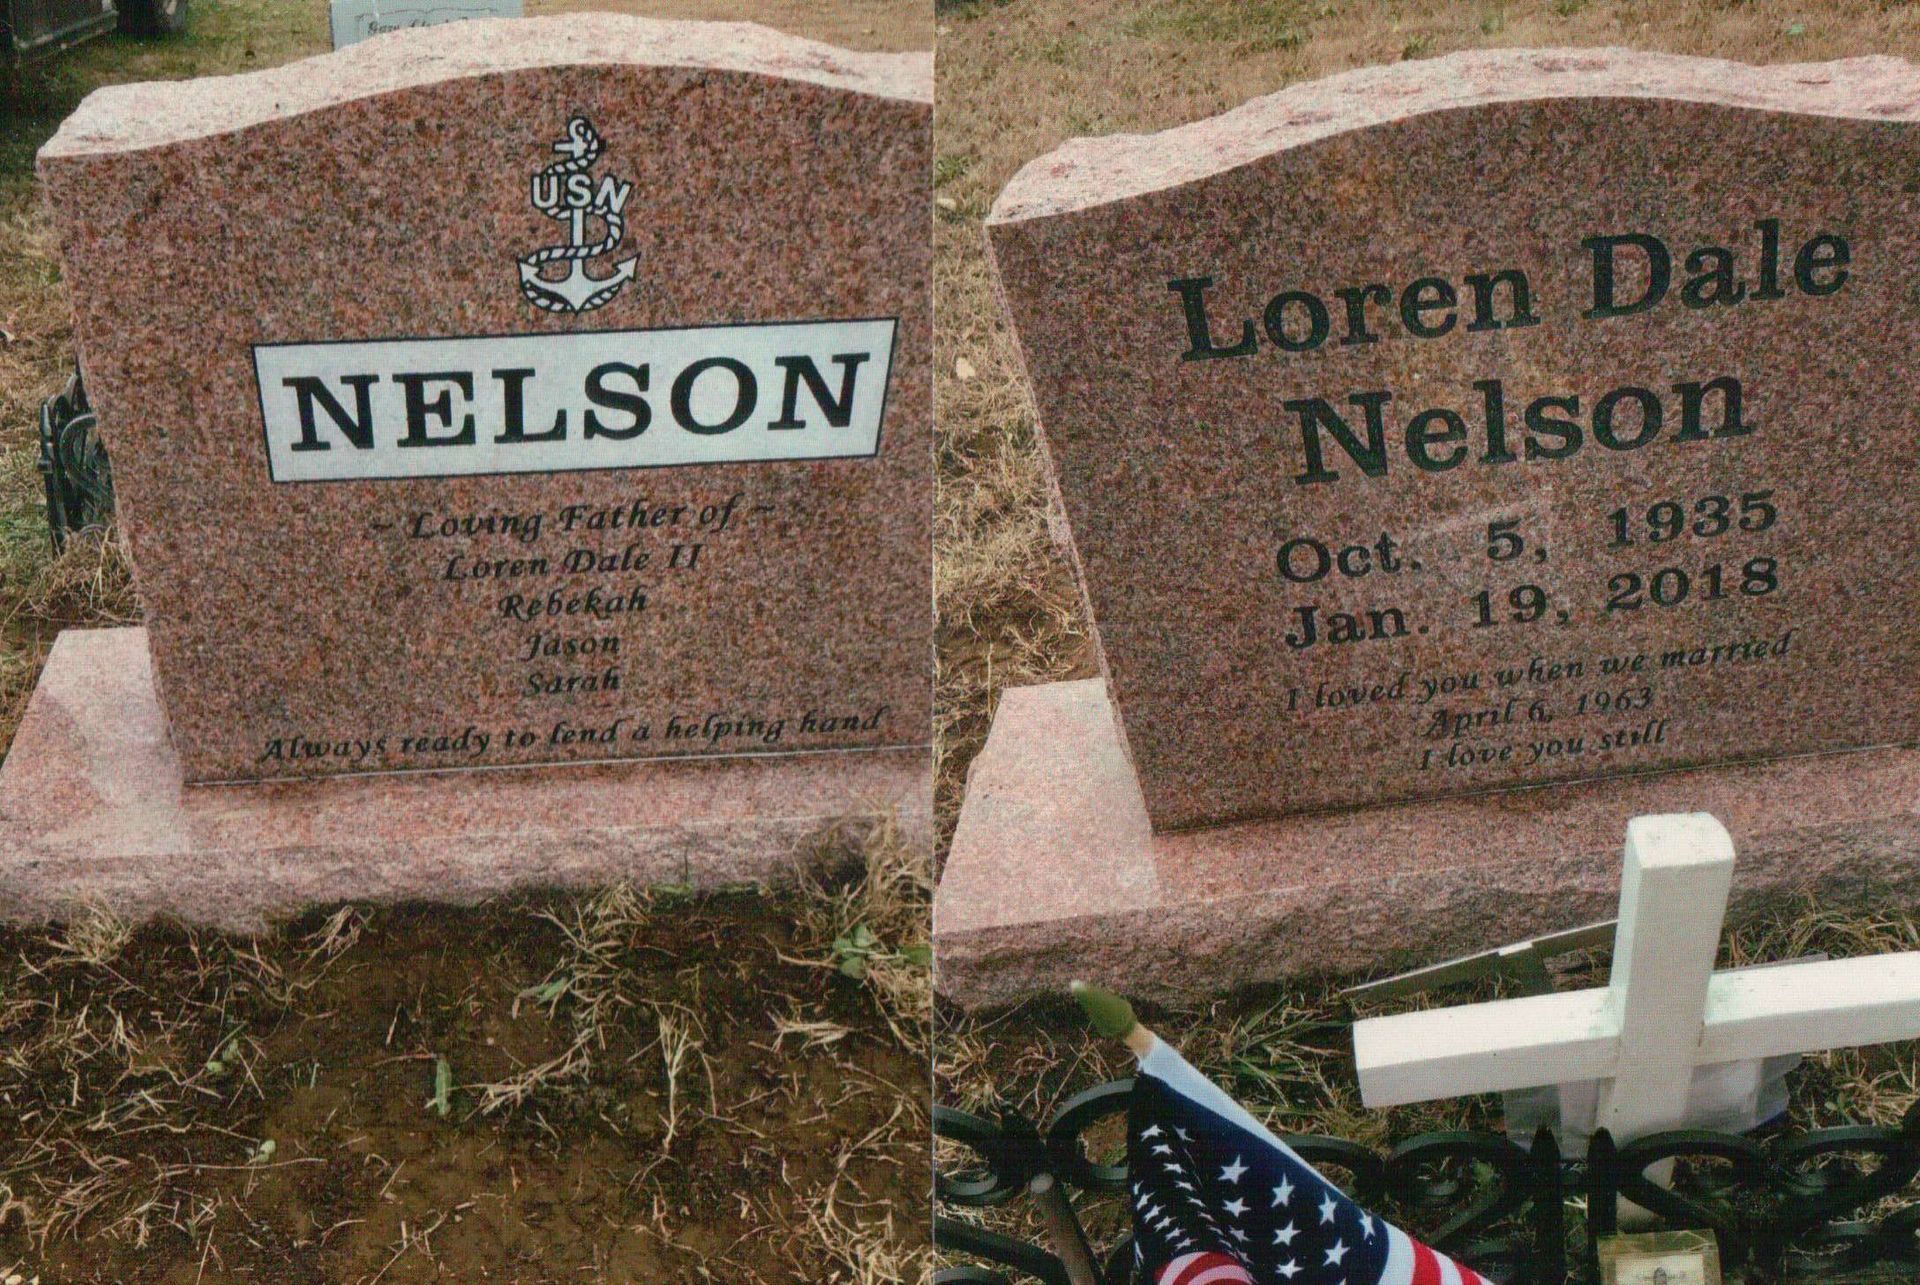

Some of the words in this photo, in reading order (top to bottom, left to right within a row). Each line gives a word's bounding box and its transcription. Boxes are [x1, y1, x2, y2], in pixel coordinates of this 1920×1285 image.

[530, 171, 634, 214] USN
[1167, 264, 1541, 362] Loren
[1580, 217, 1852, 320] Dale
[282, 351, 871, 452] NELSON
[1282, 374, 1752, 485] Nelson
[410, 511, 543, 543] Loving
[560, 500, 688, 533] Father
[698, 492, 746, 533] of
[1275, 530, 1423, 584] Oct.
[1486, 518, 1548, 564] 5,
[1607, 488, 1779, 549] 1935
[443, 554, 548, 581] Loren
[562, 545, 650, 575] Dale
[664, 543, 703, 571] II
[500, 585, 649, 622] Rebekah
[1284, 604, 1430, 650] Jan.
[1469, 583, 1571, 629] 19,
[1607, 556, 1780, 612] 2018
[520, 634, 621, 662] Jason
[1315, 671, 1410, 708] loved
[1417, 673, 1480, 704] you
[1495, 656, 1585, 688] when
[1599, 654, 1648, 675] we
[1661, 627, 1799, 667] married
[523, 667, 621, 697] Sarah
[260, 734, 388, 763] Always
[402, 726, 491, 758] ready
[505, 727, 538, 748] to
[551, 719, 627, 745] lend
[632, 720, 651, 741] a
[665, 712, 786, 747] helping
[799, 705, 889, 734] hand
[1418, 697, 1516, 739] April
[1577, 687, 1652, 716] 1963
[1419, 748, 1434, 771] I
[1449, 741, 1513, 768] love
[1524, 737, 1585, 766] you
[1601, 718, 1671, 751] still
